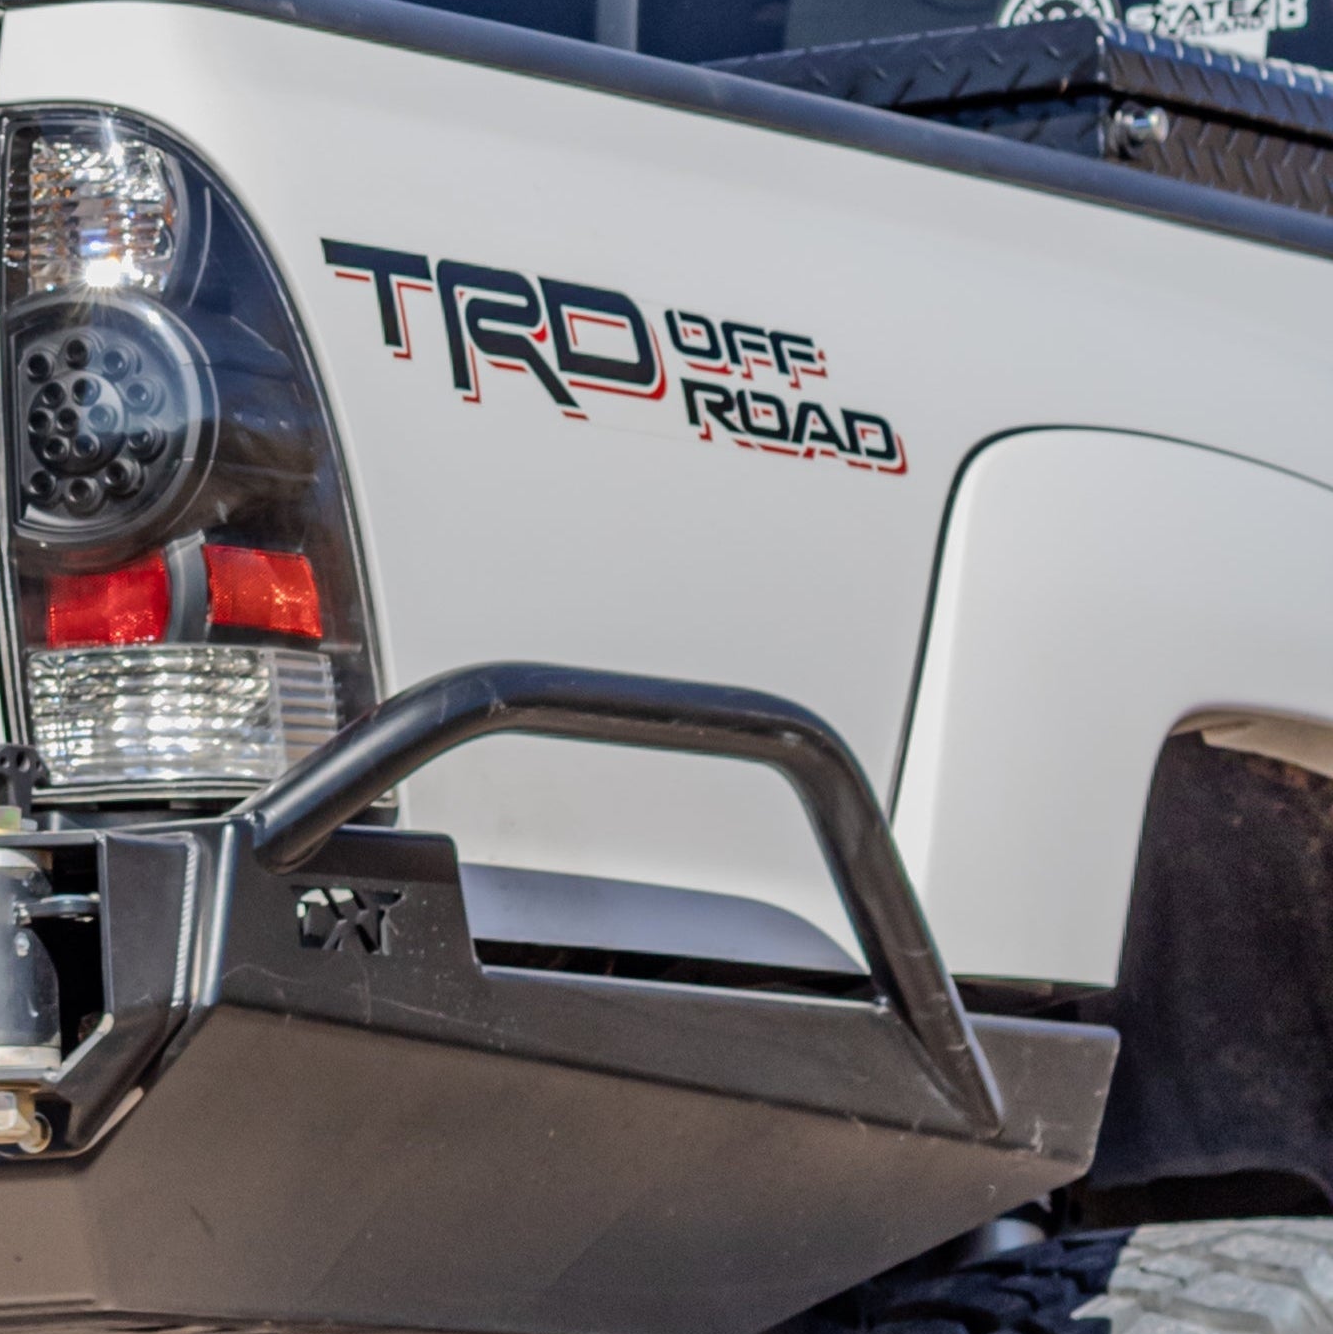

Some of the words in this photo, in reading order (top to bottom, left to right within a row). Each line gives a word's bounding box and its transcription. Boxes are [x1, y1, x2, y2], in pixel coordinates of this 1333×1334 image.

[319, 237, 667, 421] TRD
[664, 309, 828, 389] OFF
[681, 377, 908, 476] ROAD
